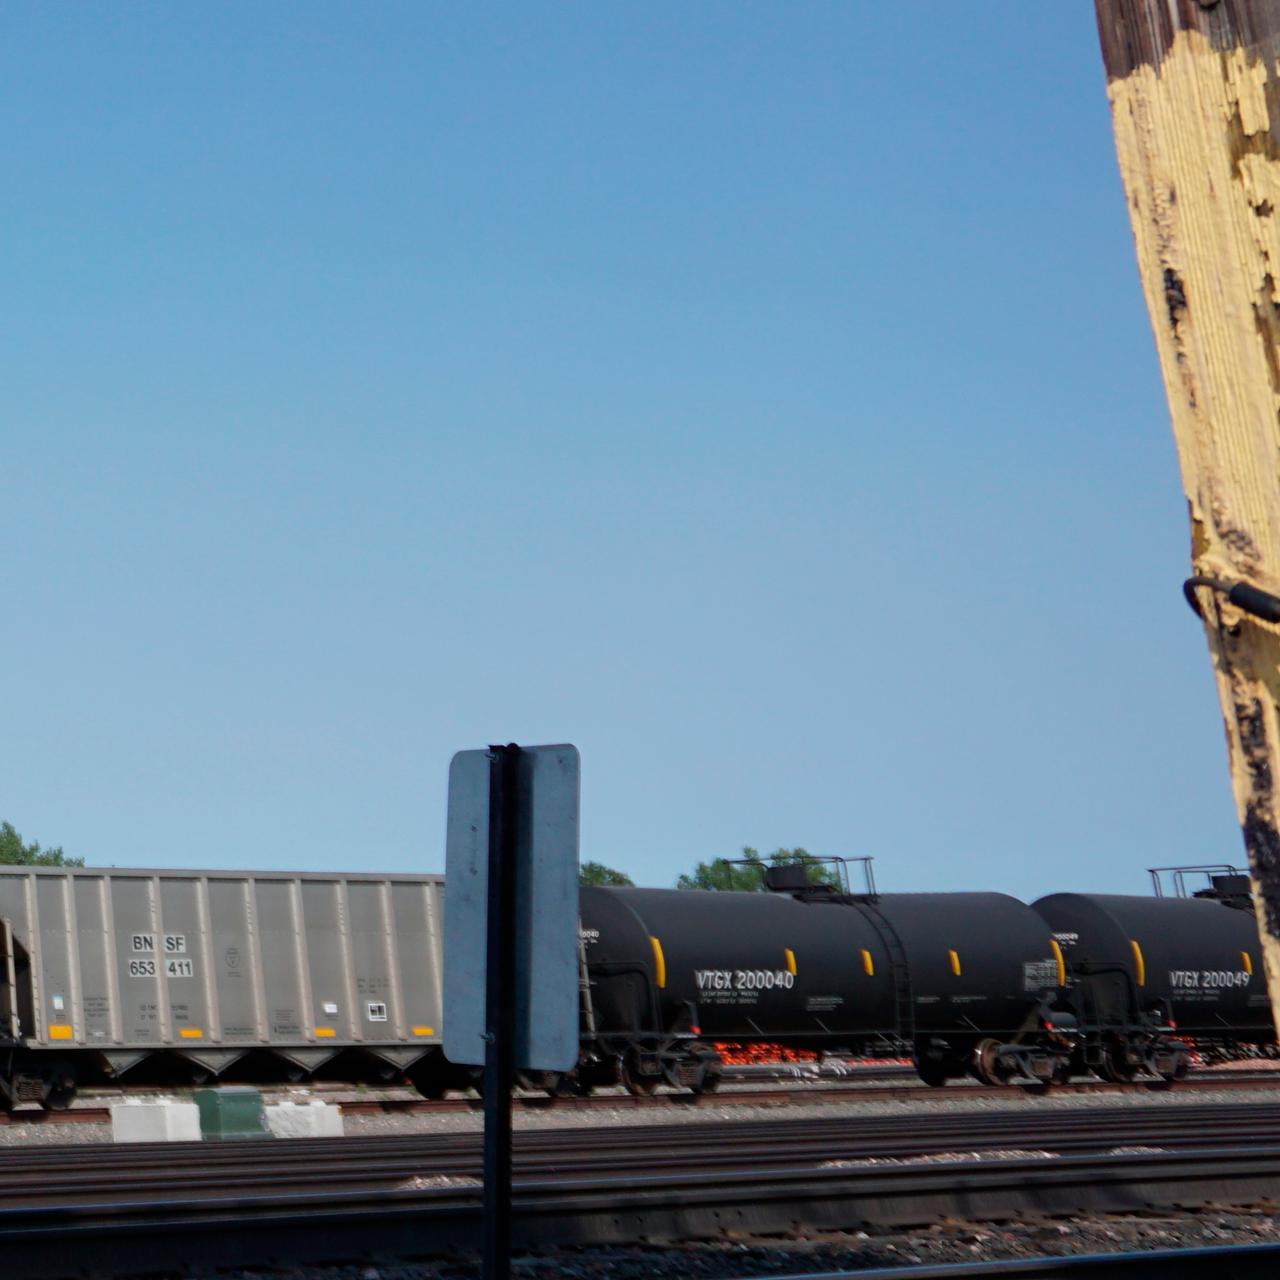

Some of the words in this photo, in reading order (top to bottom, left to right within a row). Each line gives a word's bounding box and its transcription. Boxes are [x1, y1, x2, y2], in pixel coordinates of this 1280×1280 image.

[696, 970, 732, 990] VTGX
[735, 970, 794, 990] 200040
[1169, 970, 1200, 988] VTGX
[1202, 970, 1250, 988] 200049
